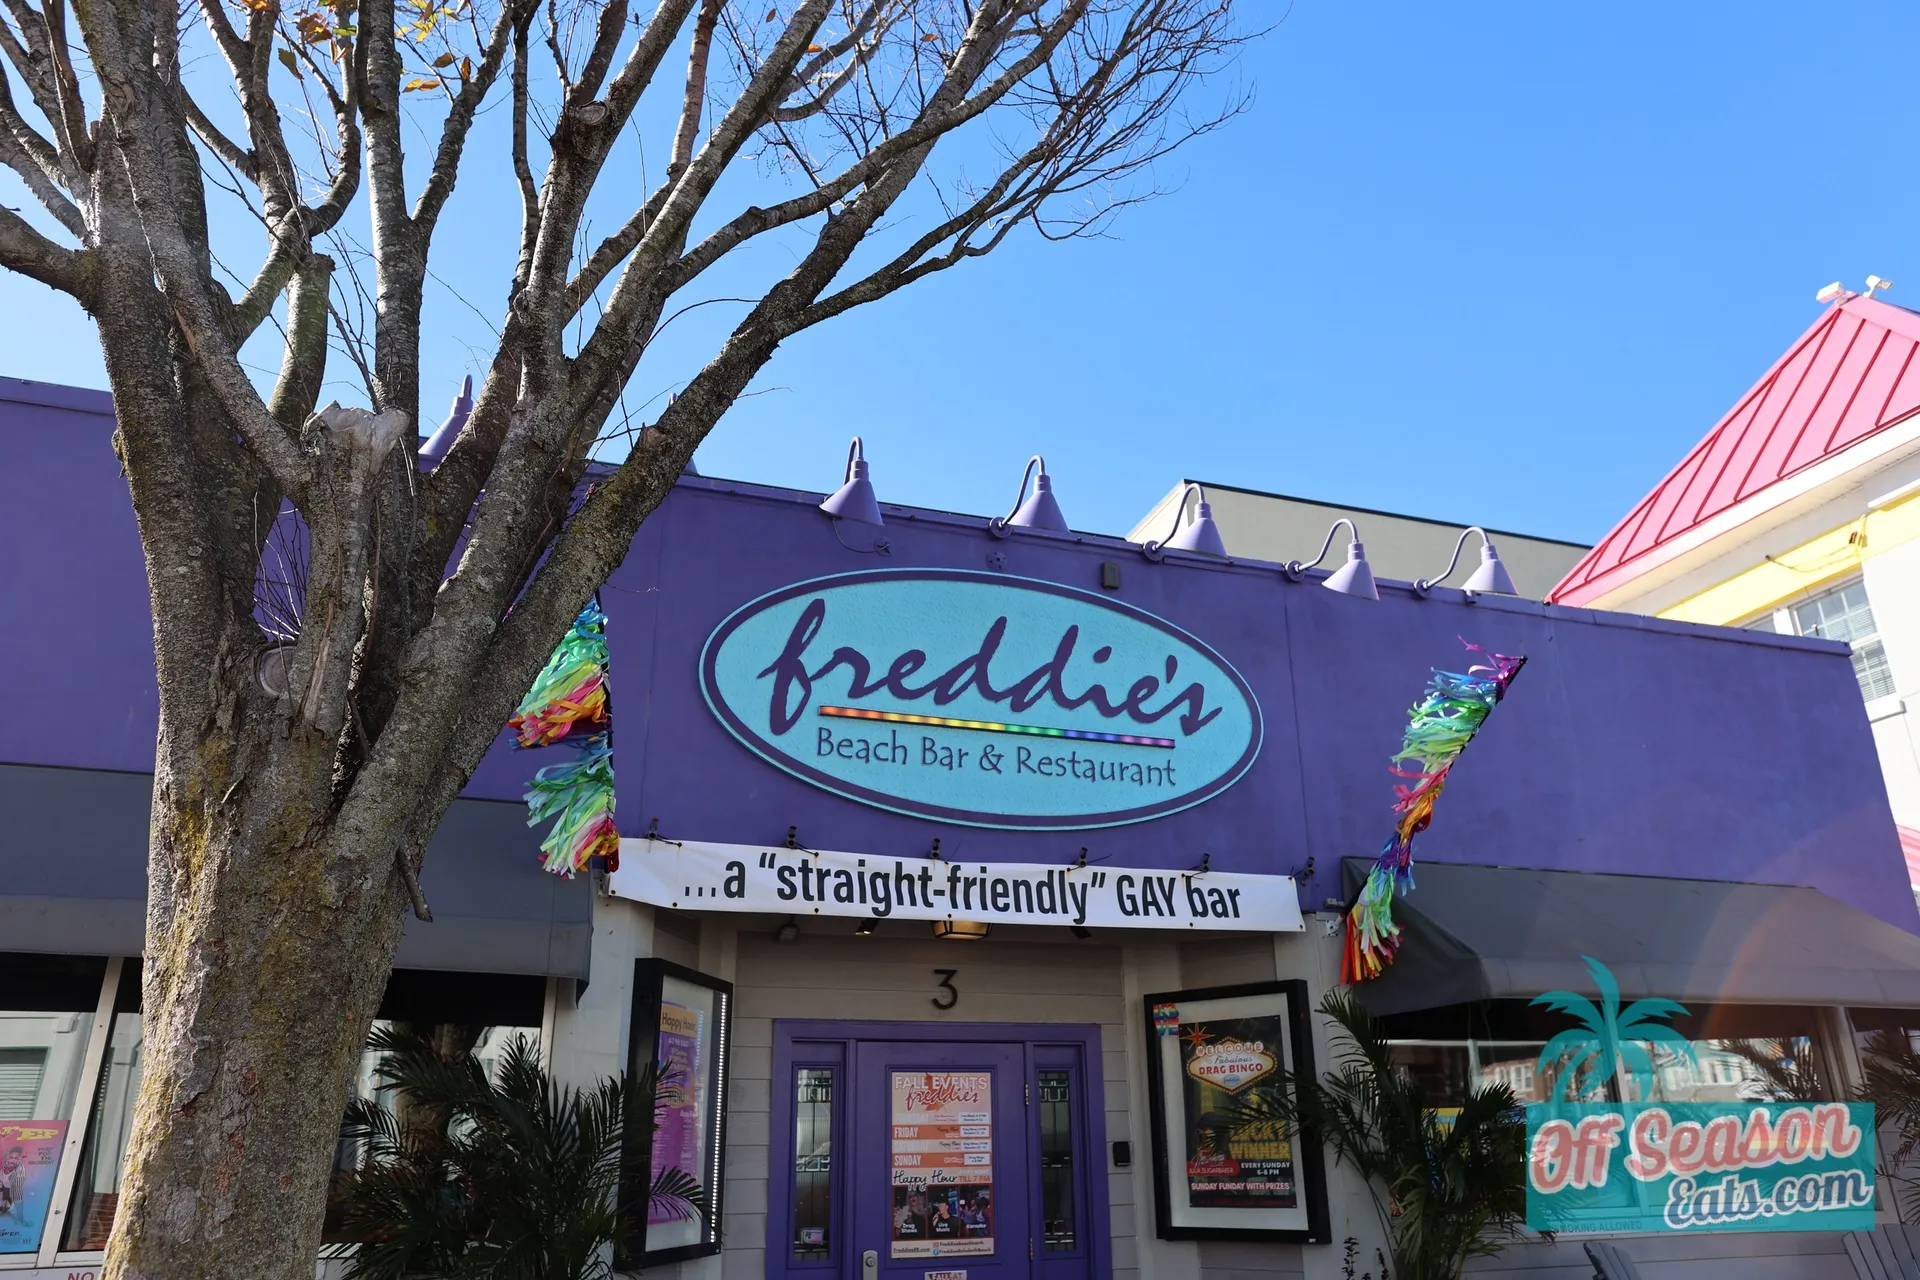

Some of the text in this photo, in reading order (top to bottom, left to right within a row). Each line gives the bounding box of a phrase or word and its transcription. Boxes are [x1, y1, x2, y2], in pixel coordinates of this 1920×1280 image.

[757, 598, 1223, 735] freddie's
[817, 727, 1177, 786] Beach Bar & Restaurant
[1116, 874, 1177, 917] GAY
[1185, 875, 1242, 918] bar
[932, 969, 958, 1010] 3
[662, 1012, 682, 1032] Happy
[1196, 1041, 1264, 1057] WELCOME
[1214, 1055, 1253, 1065] Fabulous
[1198, 1063, 1263, 1075] DRAG BINGO
[895, 1076, 988, 1090] FALL EVENTS
[905, 1084, 979, 1111] freddie's
[894, 1127, 919, 1138] FRIDAY
[1228, 1142, 1290, 1159] WINNER
[894, 1155, 922, 1166] SUNDAY
[893, 1169, 958, 1189] Happy Hour
[1191, 1182, 1290, 1190] SUNDAY FUNDAY WITH PRIZES
[1600, 1220, 1643, 1231] ALLOWED
